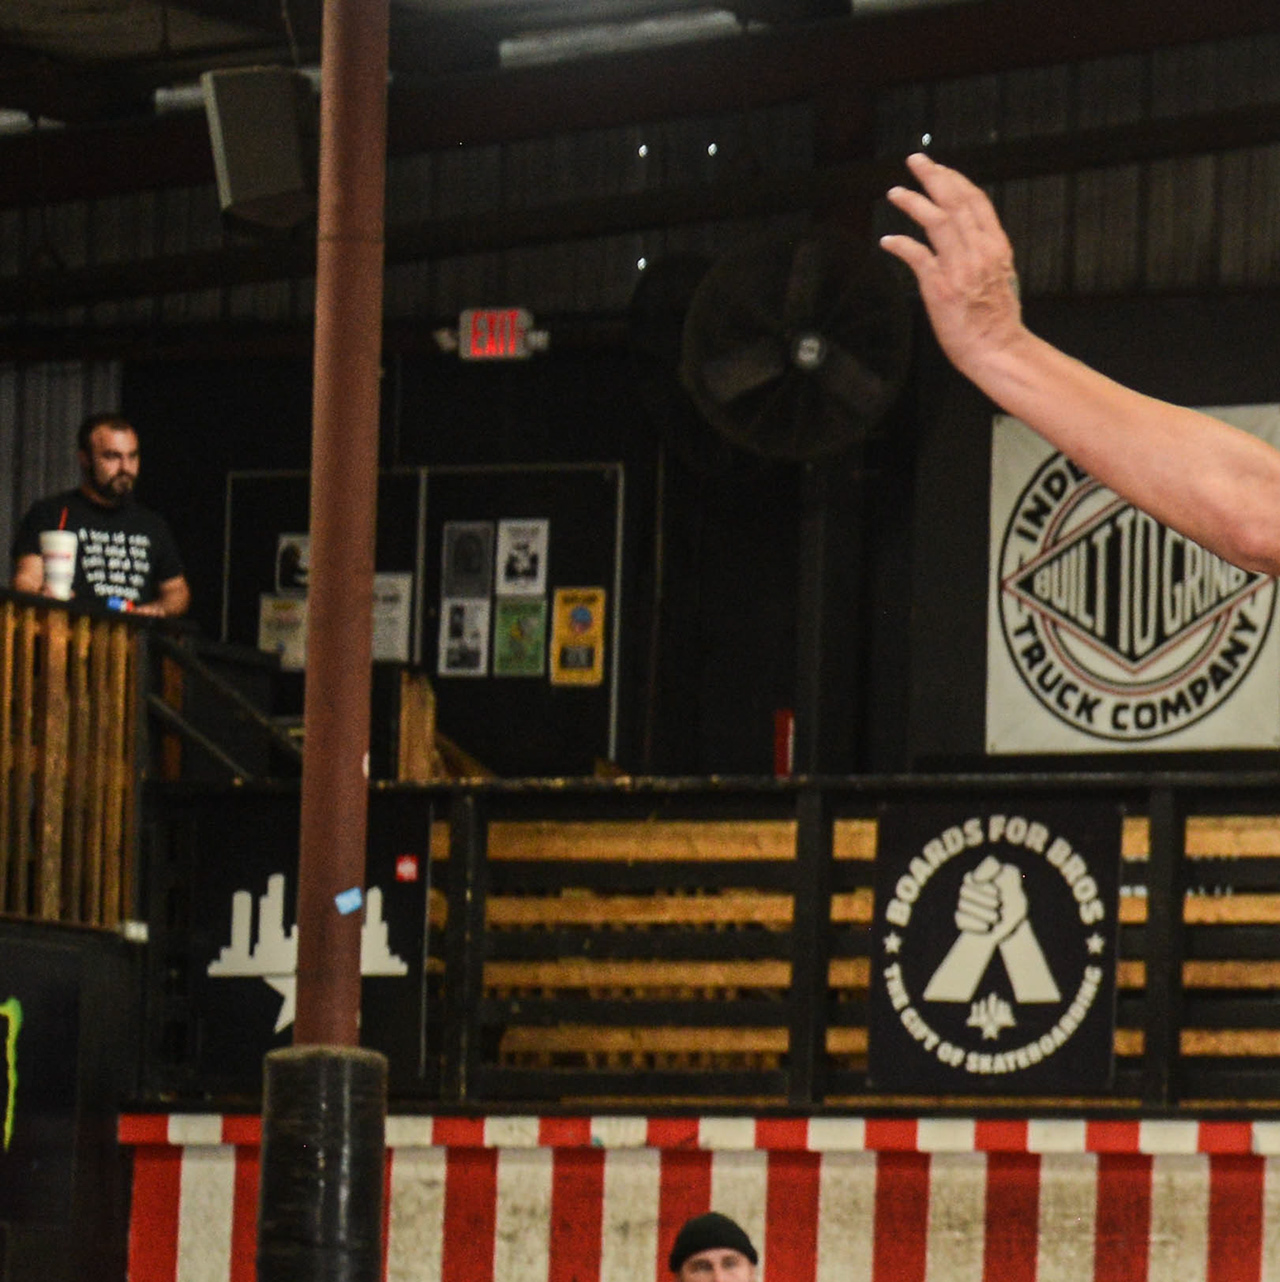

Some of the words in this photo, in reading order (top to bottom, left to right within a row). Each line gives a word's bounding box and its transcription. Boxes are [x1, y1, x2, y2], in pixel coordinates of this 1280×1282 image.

[470, 309, 519, 357] EXIT
[1031, 524, 1110, 640] BUILT
[1114, 500, 1160, 656] TO
[1013, 614, 1103, 724] TRUCK
[1111, 611, 1258, 731] COMPANY
[885, 817, 984, 928] BOARDS
[988, 814, 1049, 853] FOR
[1046, 836, 1105, 926] BROS
[884, 962, 910, 1012] THE
[937, 1041, 966, 1068] OF
[965, 966, 1103, 1075] SKATEBOARDING
